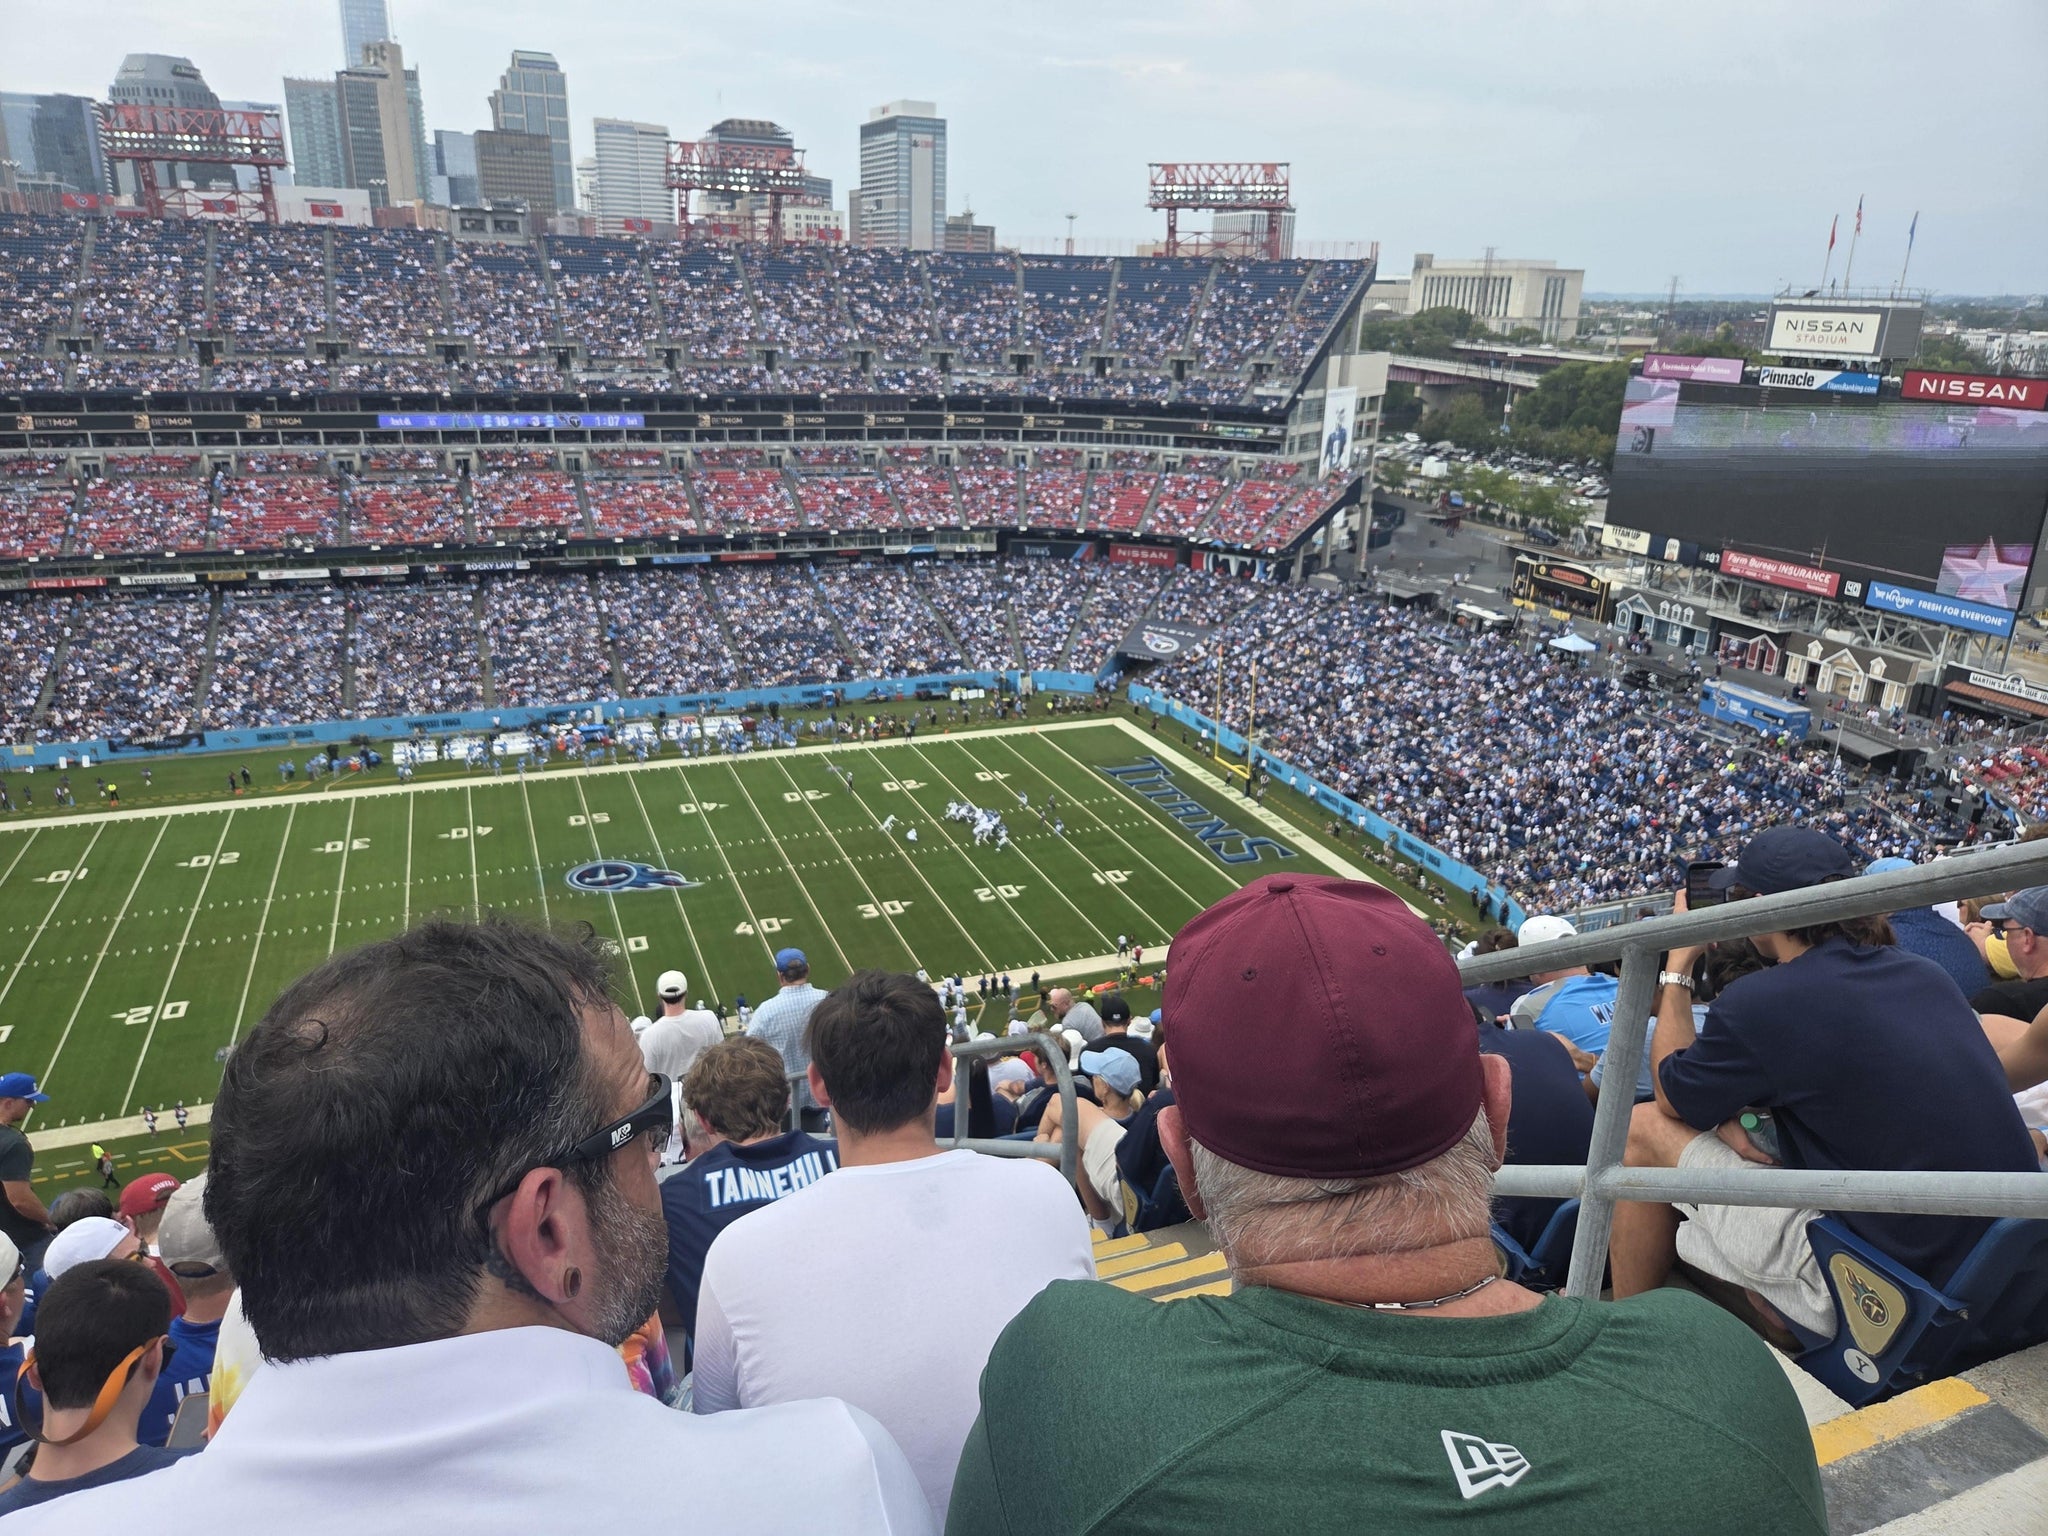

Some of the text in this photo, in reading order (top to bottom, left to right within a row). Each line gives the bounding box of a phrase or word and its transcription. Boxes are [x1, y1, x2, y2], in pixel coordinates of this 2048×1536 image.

[1786, 319, 1863, 334] NISSAN
[1796, 333, 1847, 345] STADIUM
[1761, 368, 1815, 387] Pinnacle
[1919, 377, 2028, 402] NISSAN
[1117, 548, 1168, 560] NISSAN
[465, 561, 494, 571] ROCKY
[495, 561, 514, 570] LAW
[1727, 553, 1832, 584] Farm Bureau INSURANCE
[1885, 588, 2003, 627] Kroger FRESH FOR EVERYONE
[1145, 624, 1197, 638] NISSAN
[1972, 673, 2001, 688] MARTIN'S
[1094, 755, 1298, 865] TITANS
[1092, 869, 1129, 886] 10
[973, 884, 1020, 902] 20
[857, 900, 905, 919] 30
[733, 917, 782, 936] 40
[124, 1000, 191, 1026] 20
[610, 1122, 632, 1146] M&P
[1855, 1355, 1870, 1375] Y
